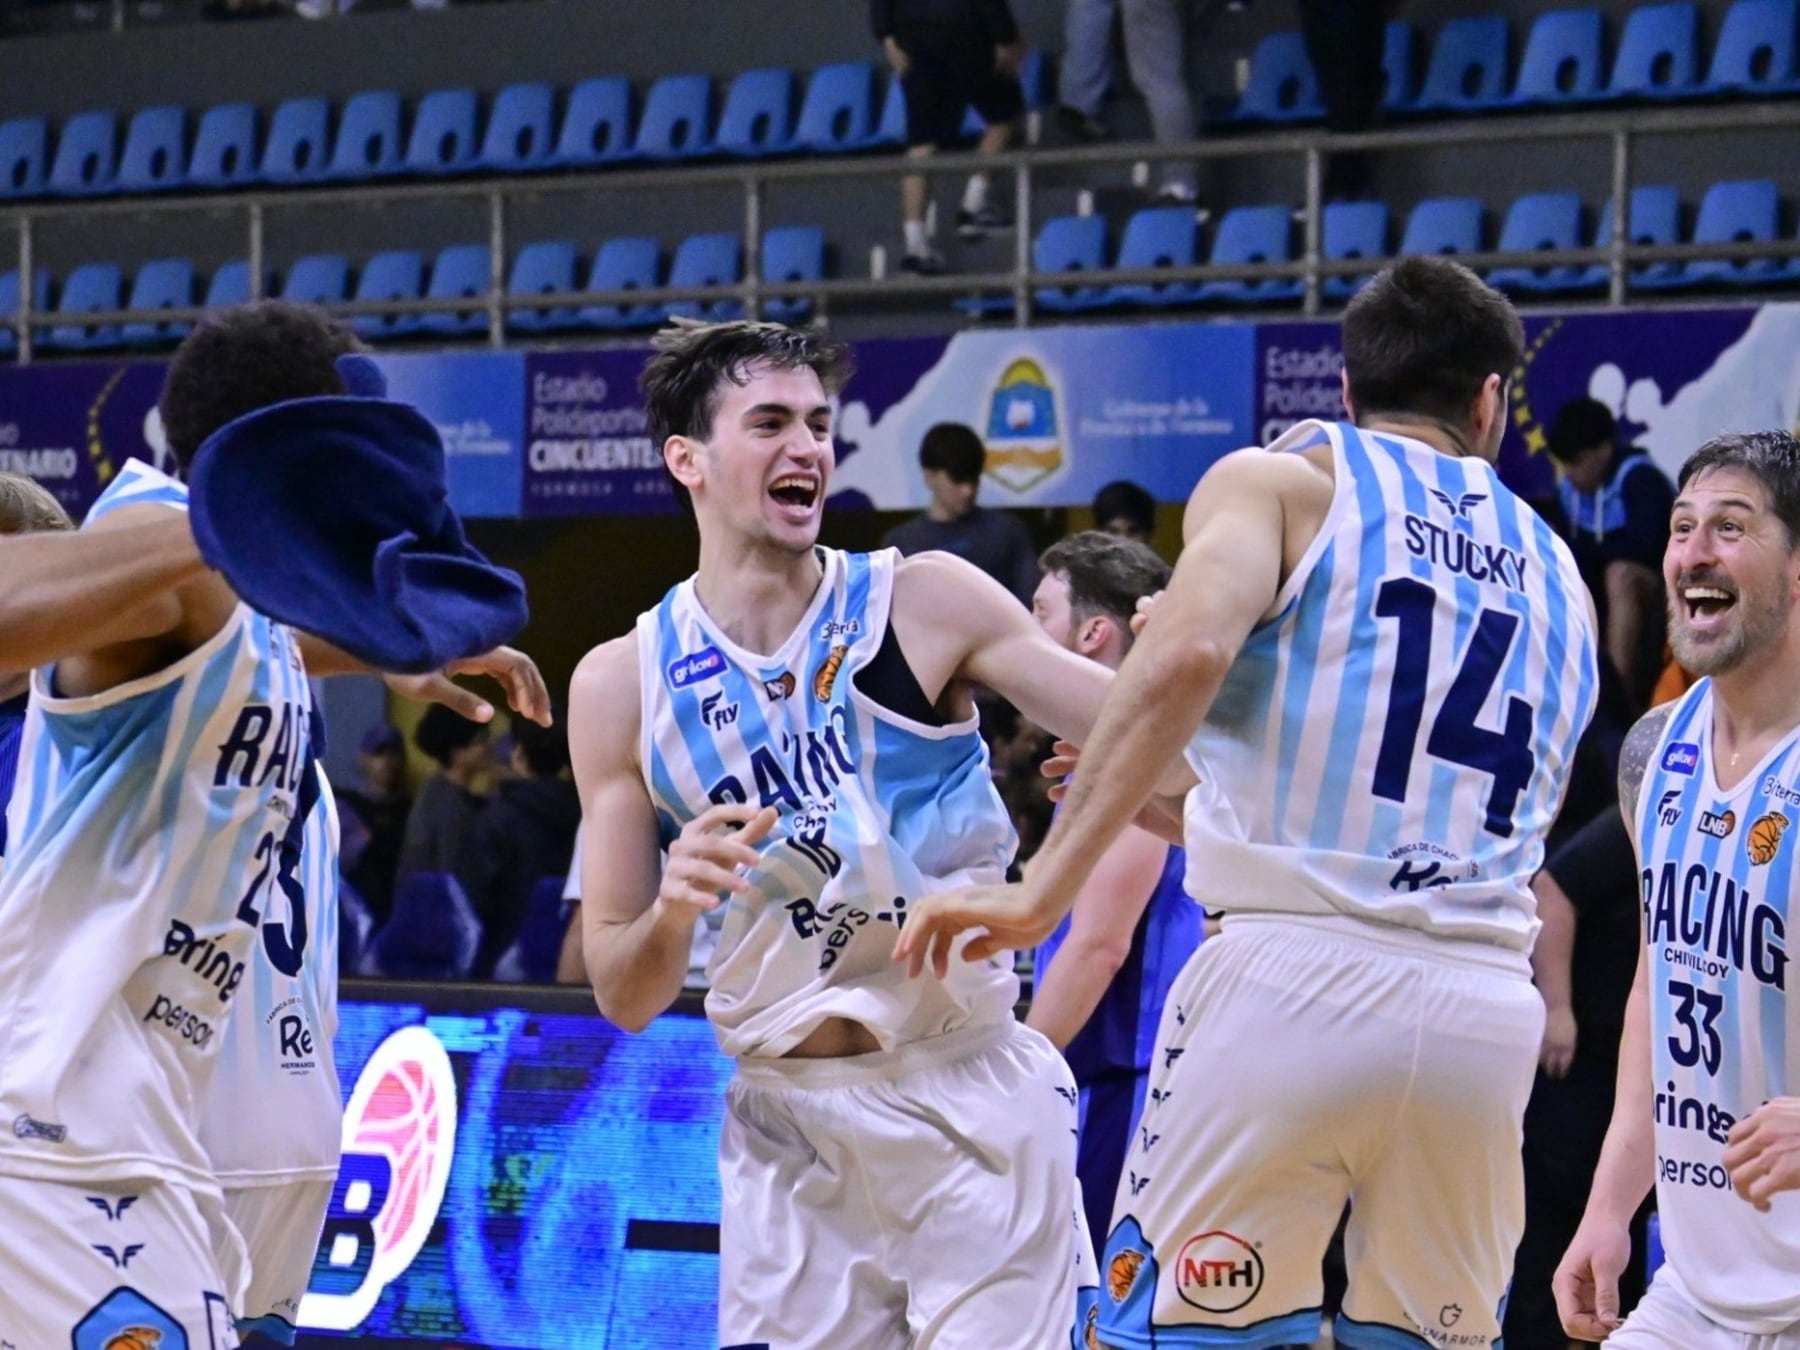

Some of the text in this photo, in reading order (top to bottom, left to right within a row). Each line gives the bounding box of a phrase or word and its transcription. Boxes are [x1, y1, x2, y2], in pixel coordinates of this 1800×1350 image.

[533, 371, 608, 403] Estadio
[1405, 514, 1527, 593] STUCKY
[1372, 577, 1535, 838] 14
[1701, 812, 1729, 837] LNB
[1643, 863, 1790, 992] RACING
[1668, 979, 1723, 1077] 33
[1184, 1258, 1253, 1288] NTH
